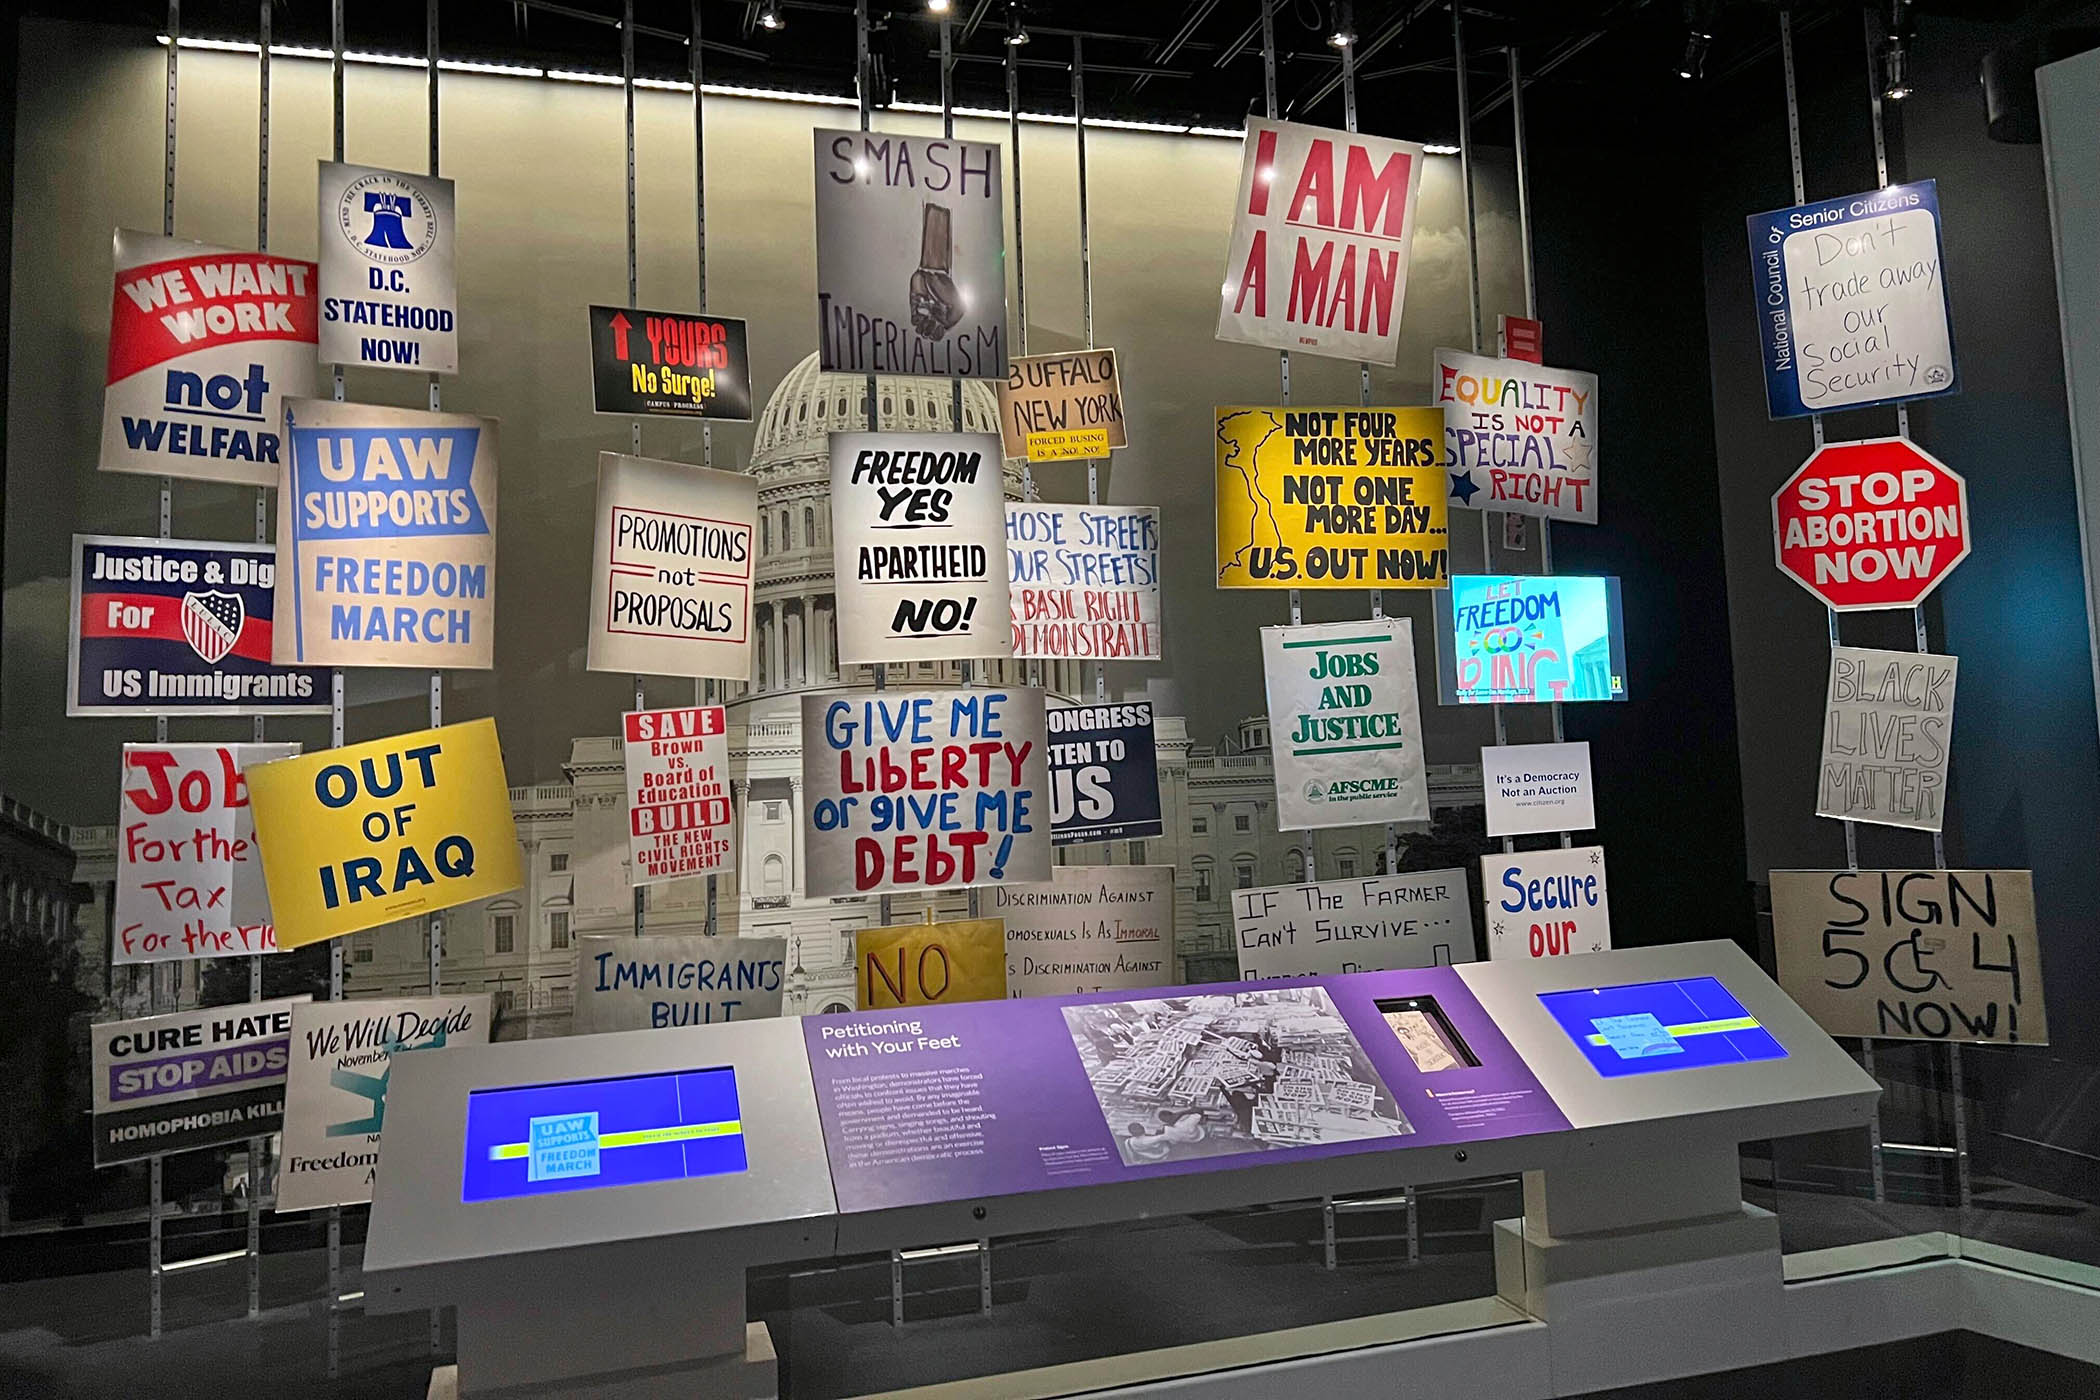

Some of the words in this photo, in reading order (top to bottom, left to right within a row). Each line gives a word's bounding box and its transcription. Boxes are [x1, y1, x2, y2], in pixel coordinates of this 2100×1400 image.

[830, 136, 992, 198] SMASH
[1249, 130, 1277, 216] I
[1286, 139, 1412, 237] AM
[1790, 208, 1845, 229] Senior
[1850, 193, 1920, 216] Citizens
[1769, 226, 1784, 244] of
[1814, 218, 1908, 265] Don't
[122, 269, 194, 314] WE
[190, 262, 309, 298] WANT
[369, 266, 409, 293] D.C.
[1233, 230, 1266, 317] A
[1286, 236, 1399, 336] MAN
[1762, 250, 1784, 306] Council
[1801, 272, 1871, 311] trade
[1880, 259, 1937, 291] away
[160, 302, 296, 344] WORK
[324, 299, 453, 332] STATEHOOD
[1844, 304, 1888, 333] our
[361, 339, 419, 365] NOW!
[646, 317, 728, 369] YOURS
[819, 293, 1000, 376] IMPERIALISM
[1776, 309, 1791, 371] National
[1803, 325, 1890, 367] Social
[165, 363, 269, 414] not
[632, 364, 657, 394] No
[661, 366, 716, 403] Surge!
[1009, 356, 1113, 390] BUFFALO
[1440, 364, 1588, 415] EQUALITY
[1807, 353, 1919, 399] Security
[1014, 400, 1067, 436] NEW
[1075, 393, 1122, 426] YORK
[1285, 413, 1338, 437] NOT
[1344, 413, 1397, 438] FOUR
[1472, 413, 1504, 431] IS
[1515, 415, 1564, 434] NOT
[1569, 421, 1585, 438] A
[120, 416, 280, 463] WELFAR
[1029, 436, 1065, 446] FORCED
[1070, 432, 1104, 443] BUSING
[1294, 439, 1357, 466] MORE
[1446, 427, 1567, 470] SPECIAL
[317, 437, 454, 483] UAW
[851, 450, 981, 484] FREEDOM
[877, 486, 953, 522] YES
[1284, 476, 1343, 504] NOT
[1354, 476, 1415, 506] ONE
[1489, 469, 1590, 512] RIGHT
[1798, 469, 1935, 510] STOP
[304, 488, 471, 529] SUPPORTS
[1305, 505, 1376, 534] MORE
[619, 514, 747, 562] PROMOTIONS
[1079, 512, 1158, 551] STREETS
[1784, 505, 1958, 549] ABORTION
[93, 552, 198, 585] Justice
[316, 556, 486, 599] FREEDOM
[659, 568, 695, 586] not
[858, 545, 986, 579] APARTHEID
[1250, 547, 1303, 579] U.S.
[1306, 547, 1368, 579] OUT
[1377, 549, 1447, 580] NOW!
[1814, 545, 1936, 584] NOW
[108, 601, 154, 629] For
[614, 590, 732, 633] PROPOSALS
[891, 597, 977, 632] NO!
[1022, 589, 1078, 621] BASIC
[1084, 591, 1141, 622] RIGHT
[1455, 591, 1561, 632] FREEDOM
[331, 605, 471, 644] MARCH
[1309, 651, 1379, 679] JOBS
[103, 670, 142, 697] US
[149, 670, 313, 700] Immigrants
[1318, 684, 1372, 710] AND
[1833, 658, 1950, 712] BLACK
[639, 710, 714, 740] SAVE
[825, 699, 933, 749] GIVE
[951, 694, 1007, 738] ME
[1046, 705, 1151, 733] ONGRESS
[1292, 713, 1401, 743] JUSTICE
[651, 740, 703, 756] Brown
[1096, 739, 1125, 762] TO
[1830, 711, 1944, 768] LIVES
[314, 744, 442, 808] OUT
[643, 768, 693, 787] Board
[699, 766, 714, 782] of
[668, 757, 689, 769] vs.
[1496, 775, 1512, 784] It's
[1524, 772, 1579, 782] Democracy
[638, 783, 721, 804] Education
[1051, 766, 1114, 824] US
[1328, 778, 1398, 794] AFSCME
[1502, 788, 1520, 797] Not
[1539, 785, 1577, 795] Auction
[1821, 763, 1943, 821] MATTER
[362, 803, 416, 842] OF
[639, 800, 724, 834] BUILD
[975, 790, 1033, 833] ME
[126, 822, 188, 863] For
[193, 827, 248, 862] the
[638, 850, 675, 864] CIVIL
[680, 840, 729, 858] RIGHTS
[654, 834, 678, 848] THE
[684, 829, 712, 844] NEW
[319, 834, 474, 909] IRAQ
[649, 855, 721, 876] MOVEMENT
[141, 880, 225, 911] Tax
[997, 886, 1092, 907] DISCRIMINATION
[1099, 884, 1154, 903] AGAINST
[1239, 892, 1279, 920] IF
[1362, 881, 1450, 906] FARMER
[1501, 867, 1598, 912] Secure
[1827, 873, 1997, 928] SIGN
[122, 923, 171, 955] For
[181, 920, 234, 954] the
[1529, 920, 1577, 957] our
[594, 952, 783, 992] IMMIGRANTS
[866, 943, 951, 1006] NO
[1024, 957, 1111, 976] DISCRIMINATION
[1113, 954, 1162, 972] AGAINST
[109, 1024, 202, 1057] CURE
[212, 1012, 289, 1043] HATE
[307, 1025, 340, 1060] We
[344, 1016, 391, 1051] Will
[396, 1005, 472, 1043] Decide
[822, 1021, 922, 1039] Petitioning
[1878, 999, 2019, 1043] NOW!
[825, 1043, 868, 1058] with
[872, 1041, 913, 1054] Your
[918, 1034, 960, 1050] Feet
[118, 1060, 206, 1094] STOP
[209, 1047, 287, 1080] AIDS
[110, 1108, 243, 1144] HOMOPHOBIA
[537, 1131, 591, 1148] SUPPORTS
[540, 1119, 585, 1135] UAW
[541, 1148, 596, 1162] FREEDOM
[546, 1160, 592, 1173] MARCH
